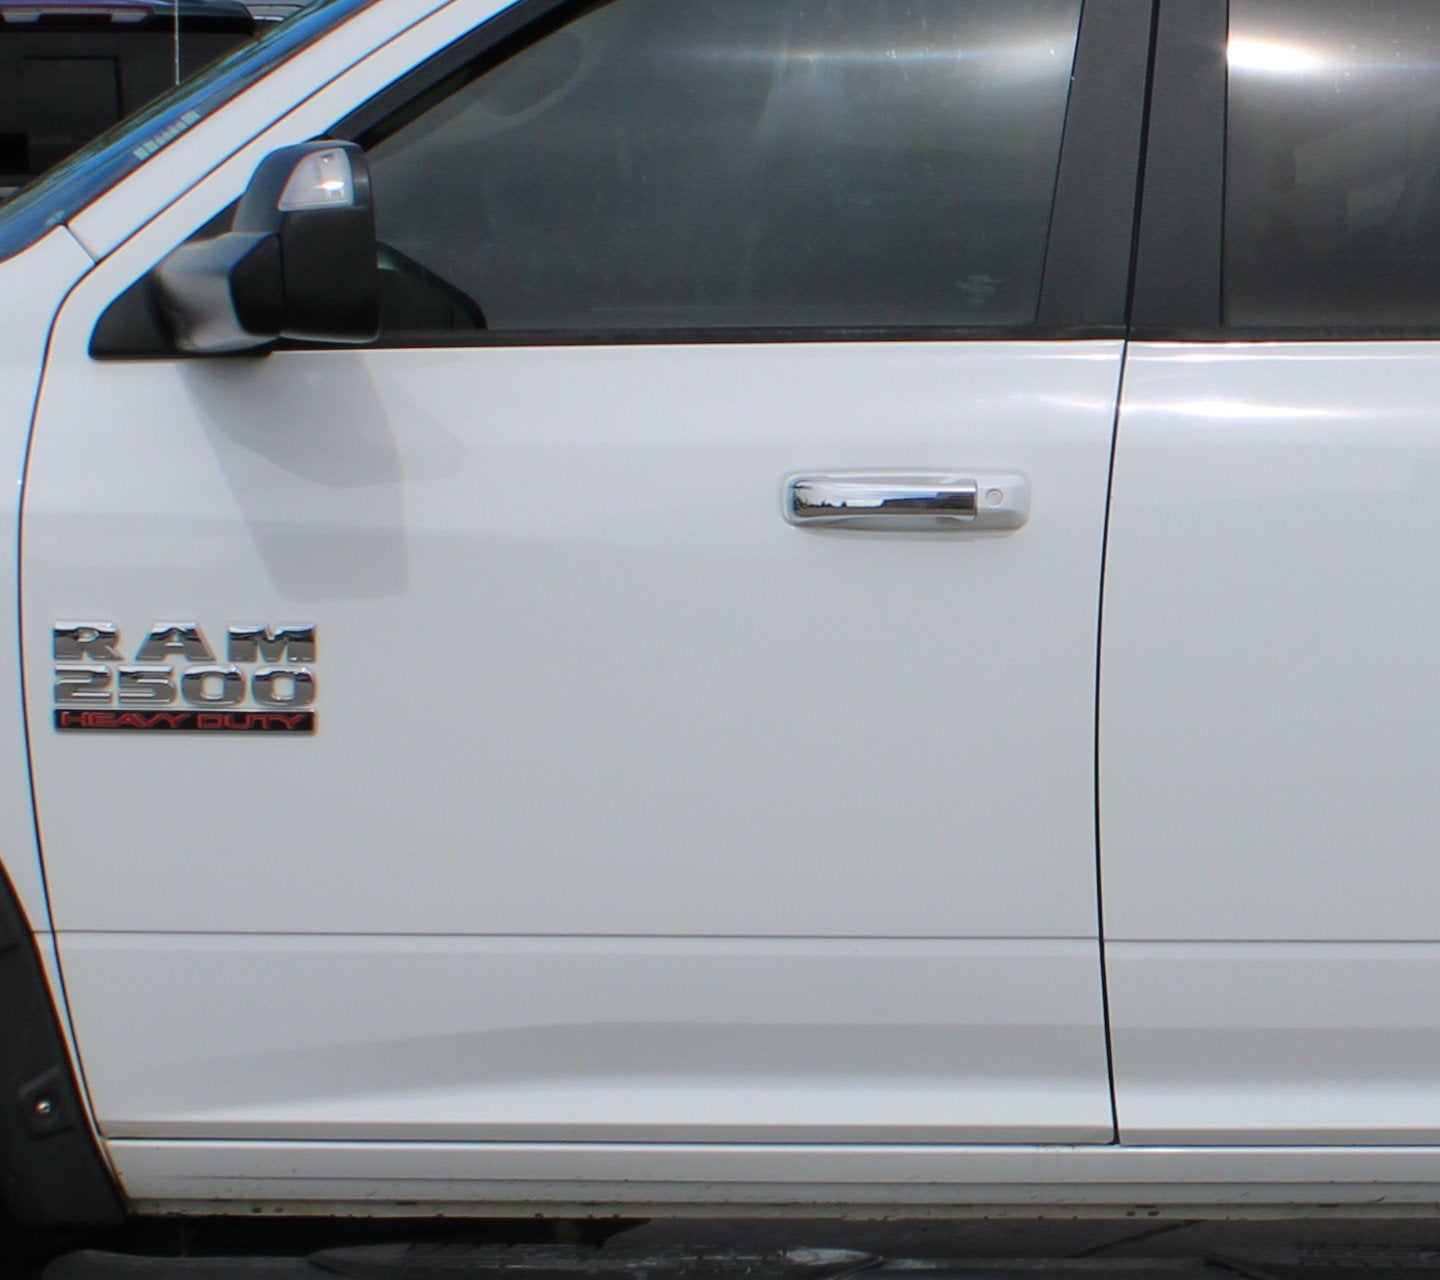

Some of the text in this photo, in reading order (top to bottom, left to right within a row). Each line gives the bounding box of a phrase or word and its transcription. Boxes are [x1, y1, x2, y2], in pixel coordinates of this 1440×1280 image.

[54, 620, 317, 663] RAM
[54, 664, 317, 708] 2500
[60, 711, 306, 730] HEAVY DUTY
